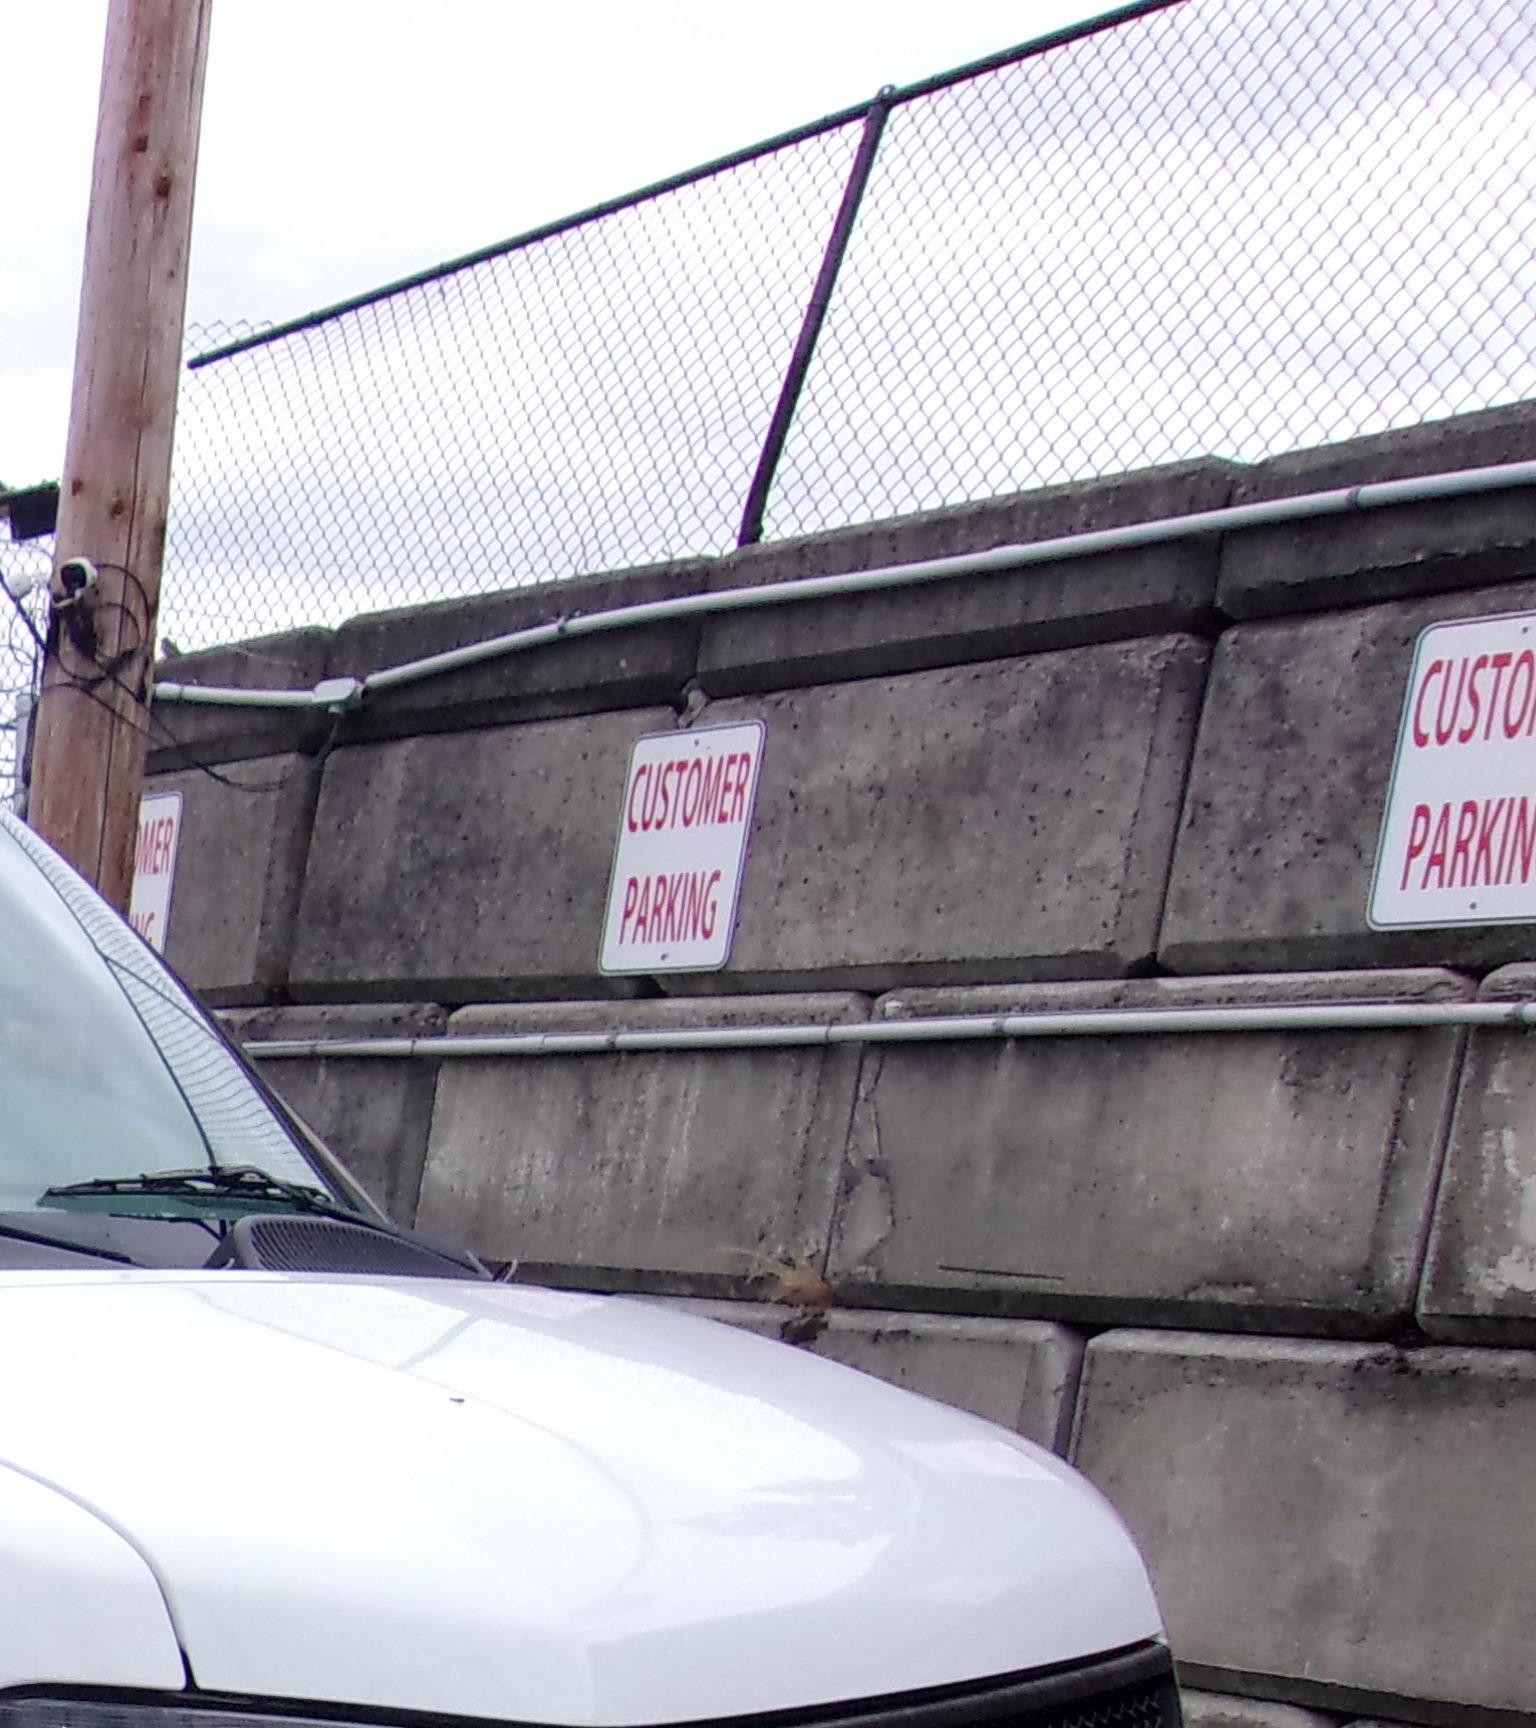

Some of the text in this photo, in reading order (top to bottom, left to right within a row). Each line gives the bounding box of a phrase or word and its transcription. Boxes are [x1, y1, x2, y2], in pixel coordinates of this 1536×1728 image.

[1413, 648, 1536, 748] CUSTO
[628, 751, 751, 833] CUSTOMER
[619, 869, 722, 945] PARKING
